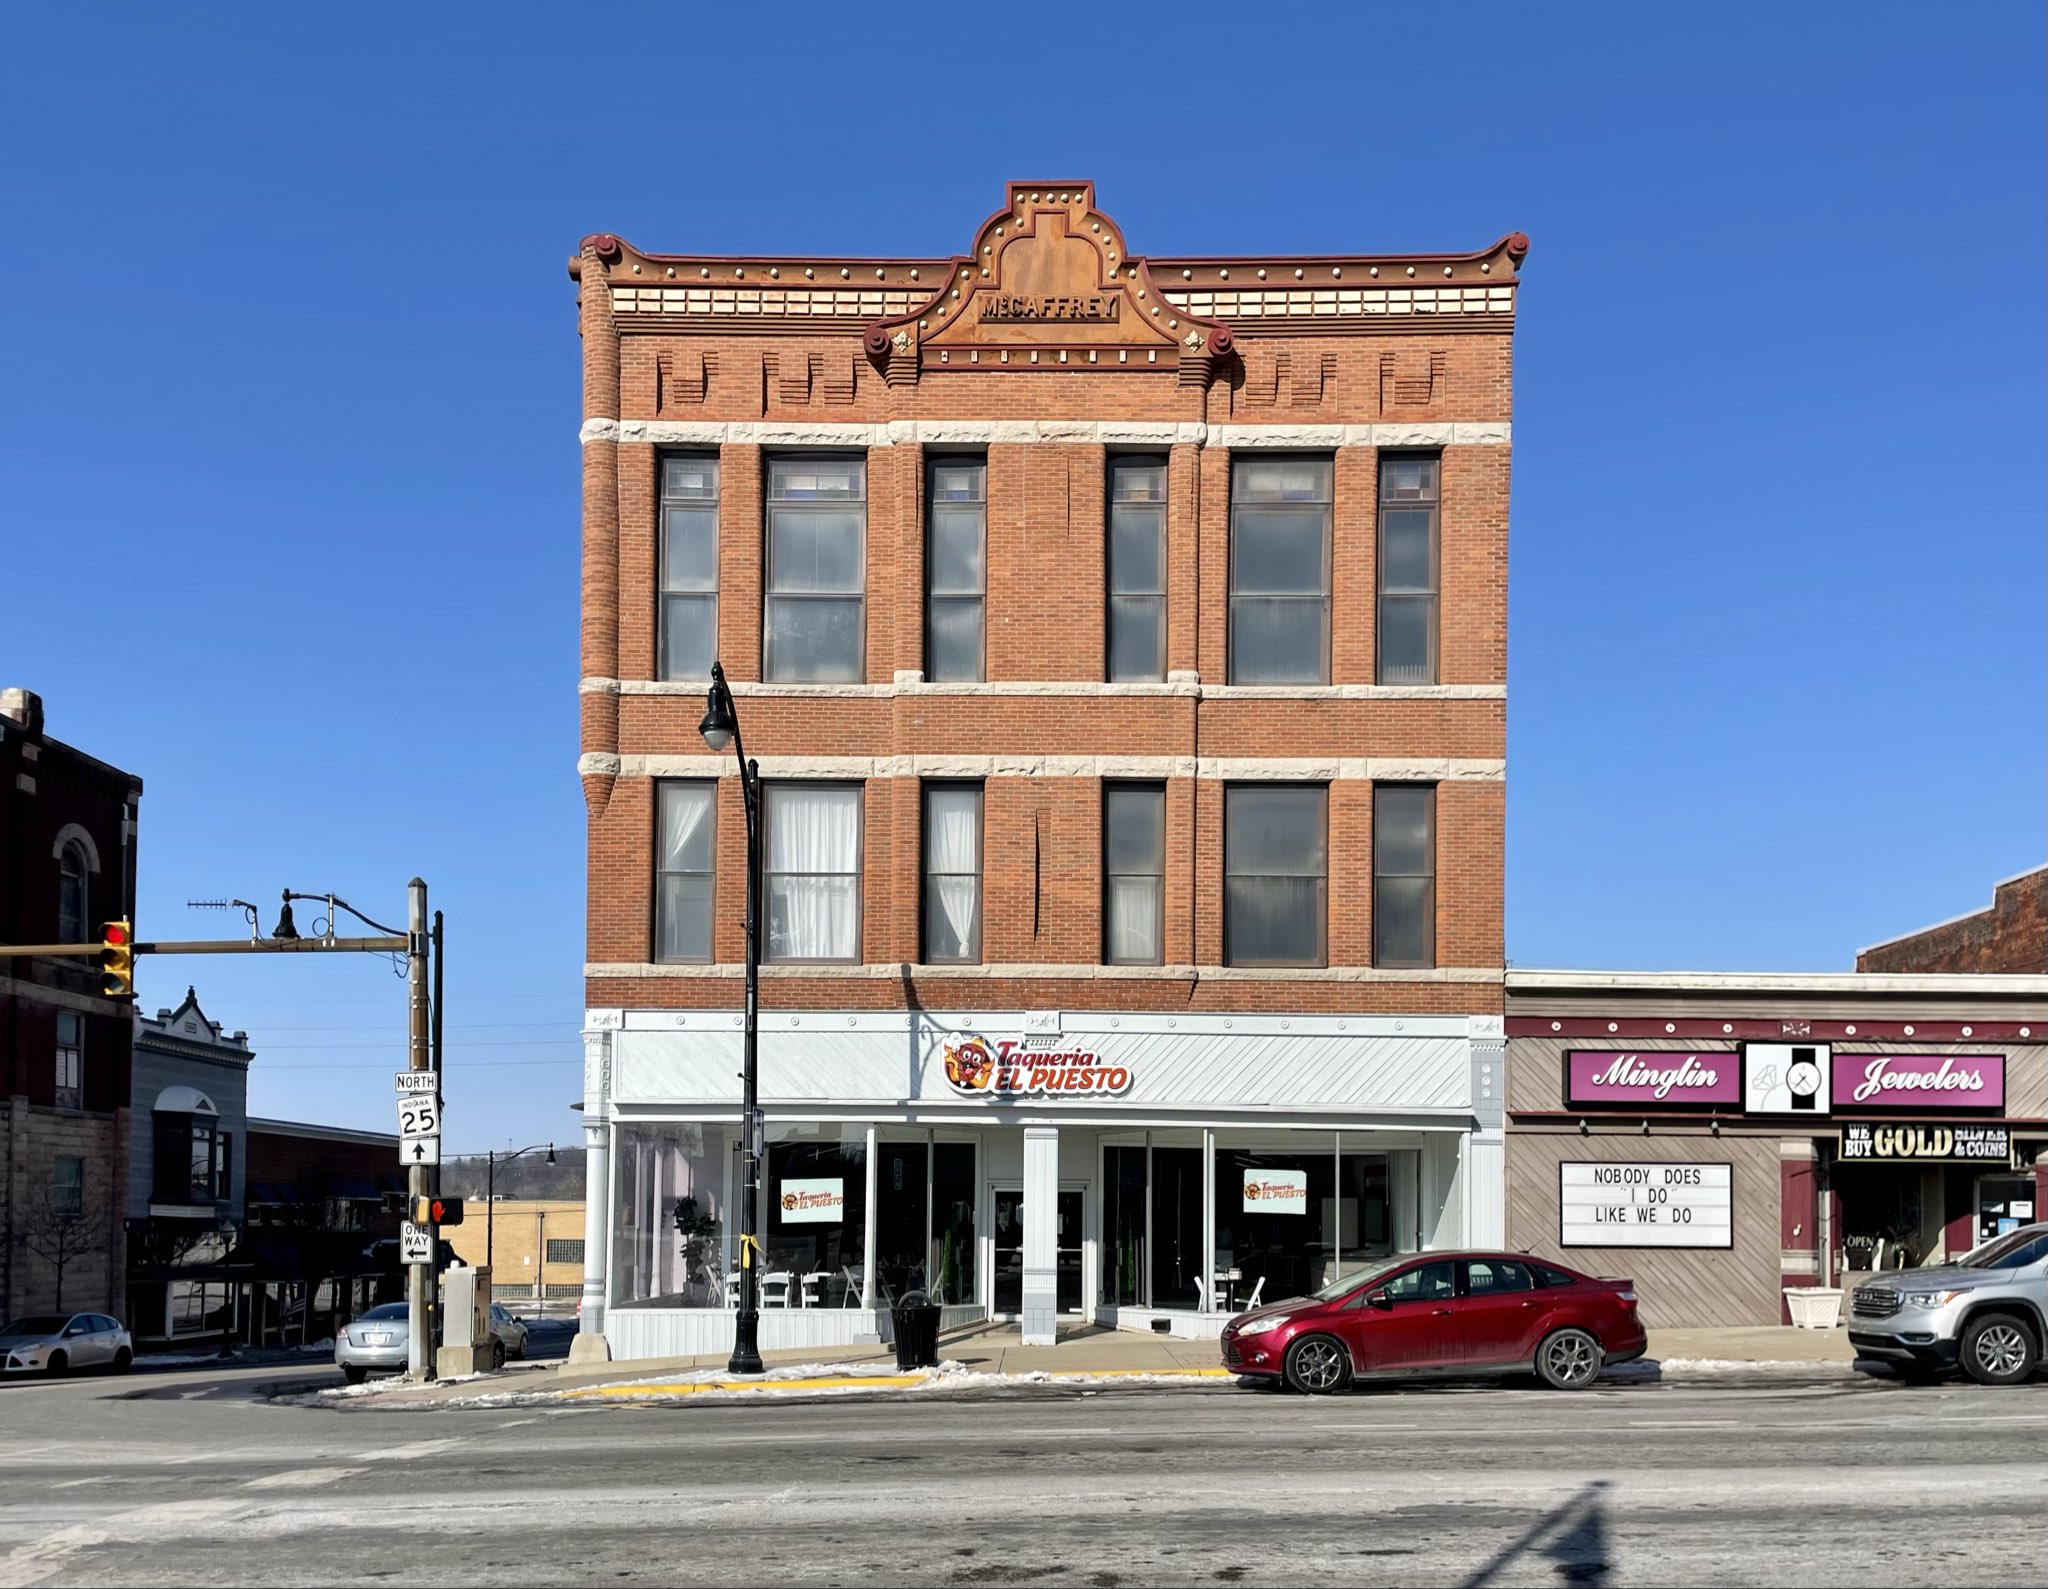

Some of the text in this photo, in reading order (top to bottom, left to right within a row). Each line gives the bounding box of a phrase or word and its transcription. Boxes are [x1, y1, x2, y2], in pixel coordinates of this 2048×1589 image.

[997, 1041, 1094, 1071] Taqueria
[397, 1075, 435, 1088] NORTH
[995, 1067, 1128, 1090] EL PUESTO
[1592, 1055, 1718, 1099] Minglin
[1853, 1058, 1984, 1101] Jewelers
[402, 1099, 430, 1109] INDIANA
[401, 1108, 435, 1134] 25
[1848, 1123, 1870, 1140] WE
[1954, 1125, 2008, 1141] SILVER
[1844, 1140, 1873, 1157] BUY
[1874, 1124, 1953, 1157] GOLD
[1954, 1142, 2008, 1157] & COINS
[1594, 1168, 1702, 1185] NOBODY DOES
[1262, 1182, 1295, 1193] Taqueria
[1262, 1189, 1306, 1200] EL PUESTO
[799, 1191, 832, 1201] Taqueria
[799, 1197, 843, 1209] EL PUESTO
[1595, 1207, 1692, 1223] LIKE WE DO
[405, 1225, 429, 1235] ONE
[404, 1236, 429, 1246] WAY
[1847, 1235, 1874, 1247] OPEN
